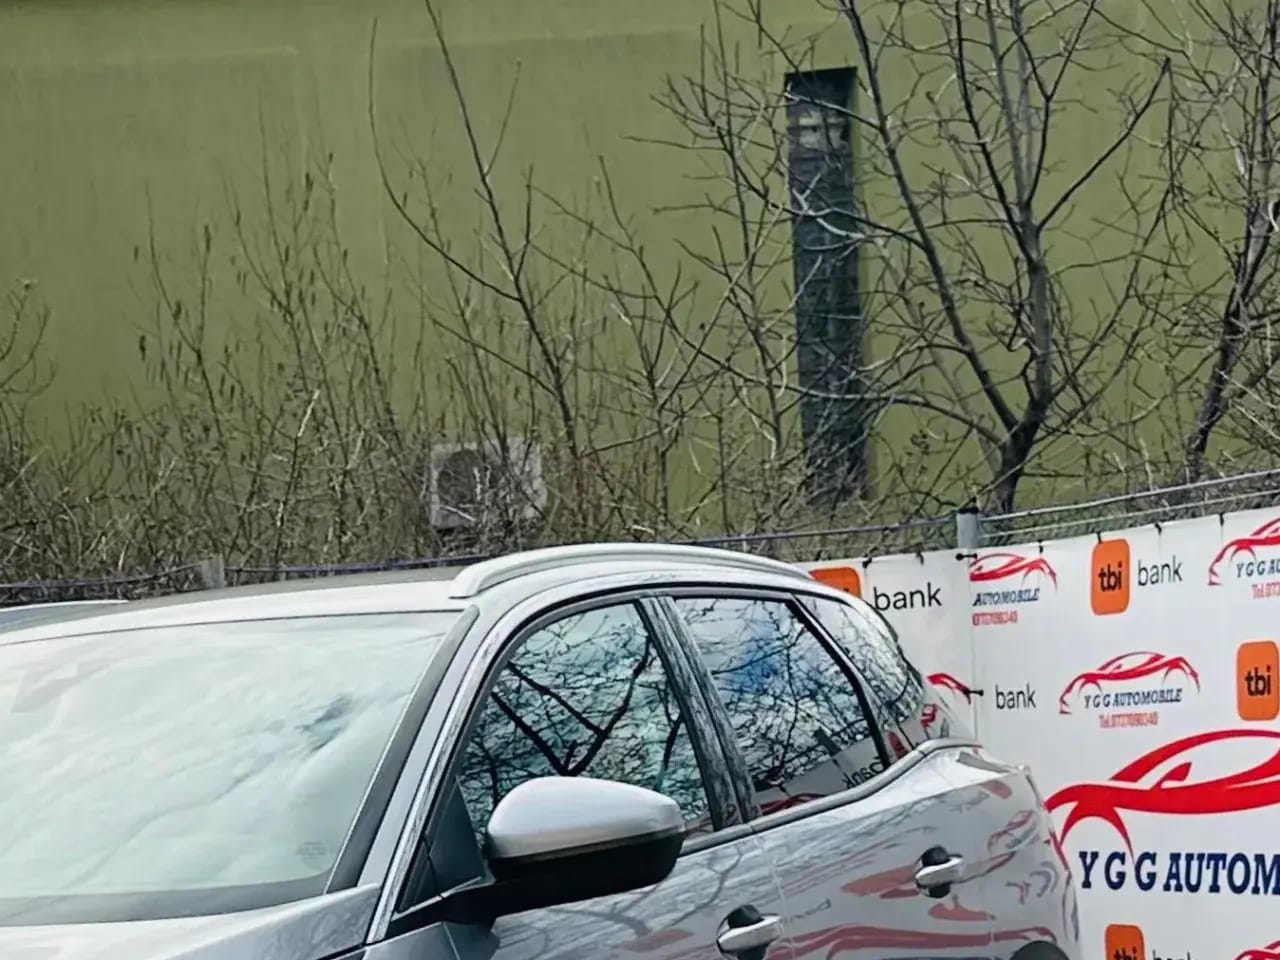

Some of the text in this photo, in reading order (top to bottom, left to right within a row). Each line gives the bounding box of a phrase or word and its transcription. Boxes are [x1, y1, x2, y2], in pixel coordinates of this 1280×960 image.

[1098, 555, 1183, 592] tbi bank
[873, 582, 942, 611] bank
[1245, 665, 1271, 697] tbi
[995, 683, 1036, 709] bank
[1112, 688, 1183, 707] AUTOMOBILE
